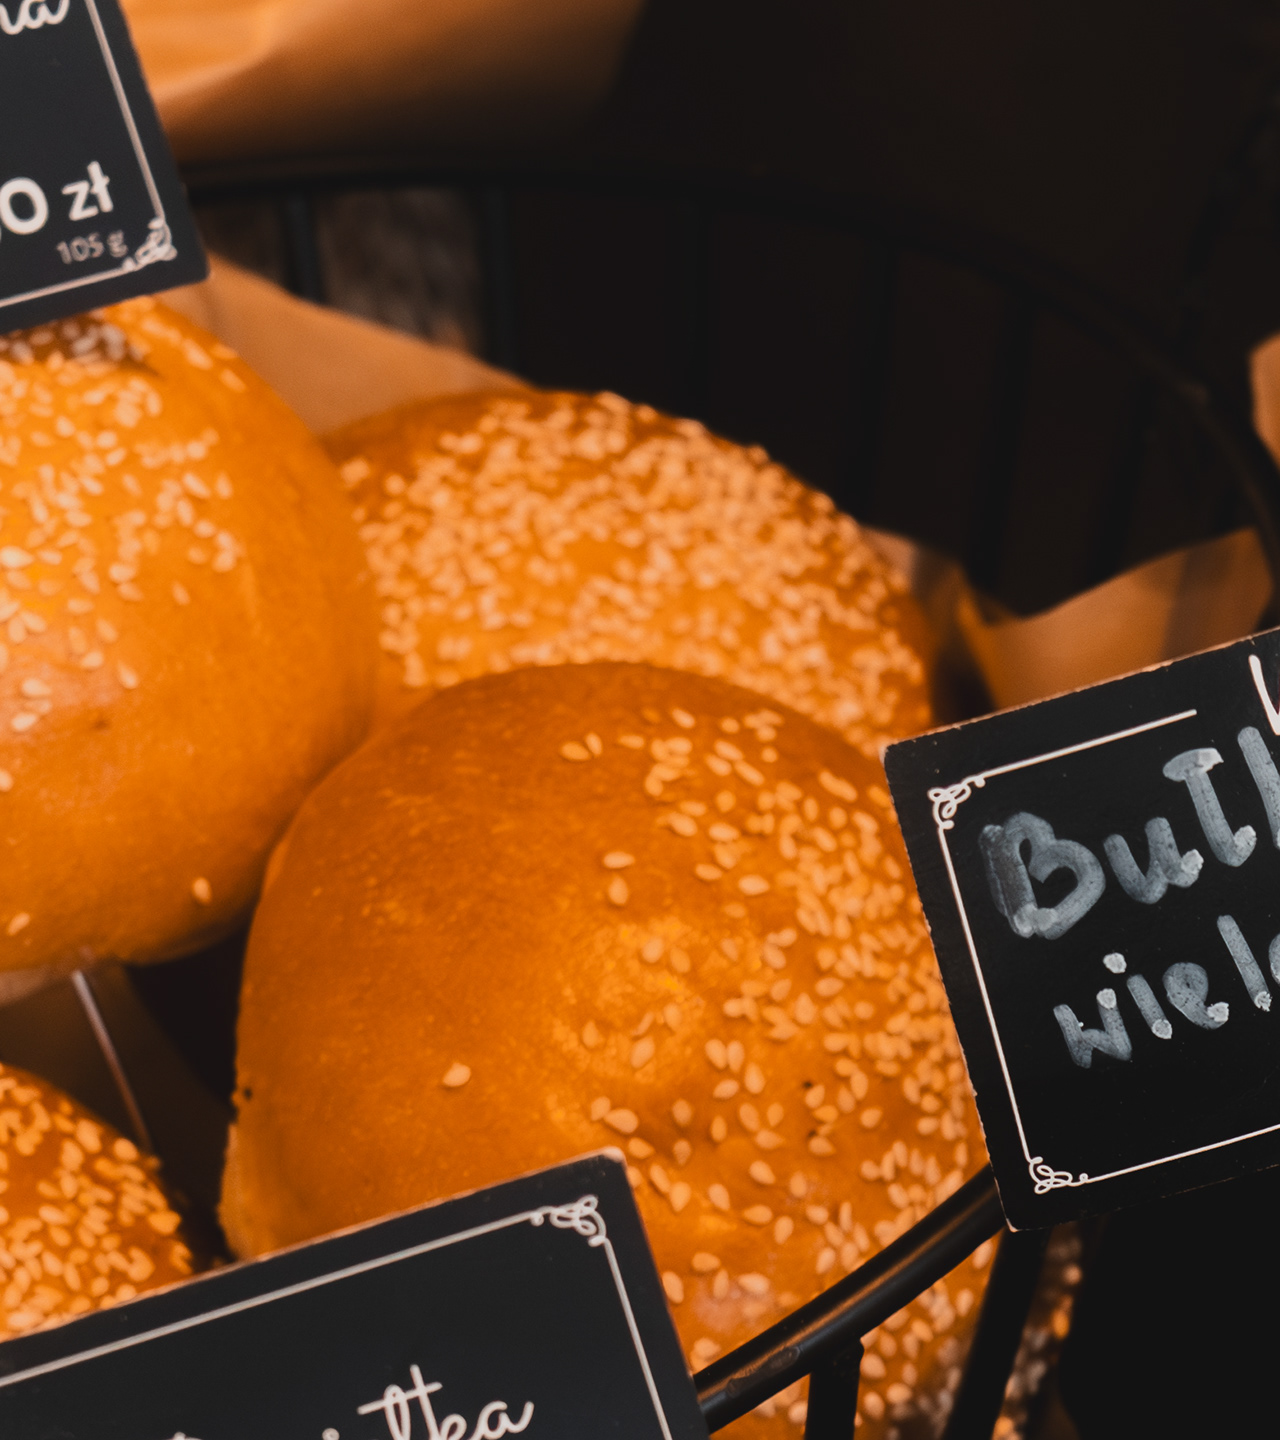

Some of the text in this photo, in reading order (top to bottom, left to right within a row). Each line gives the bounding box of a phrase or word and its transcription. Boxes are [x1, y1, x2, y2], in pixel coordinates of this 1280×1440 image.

[61, 160, 114, 222] zł
[56, 228, 129, 265] 105 g
